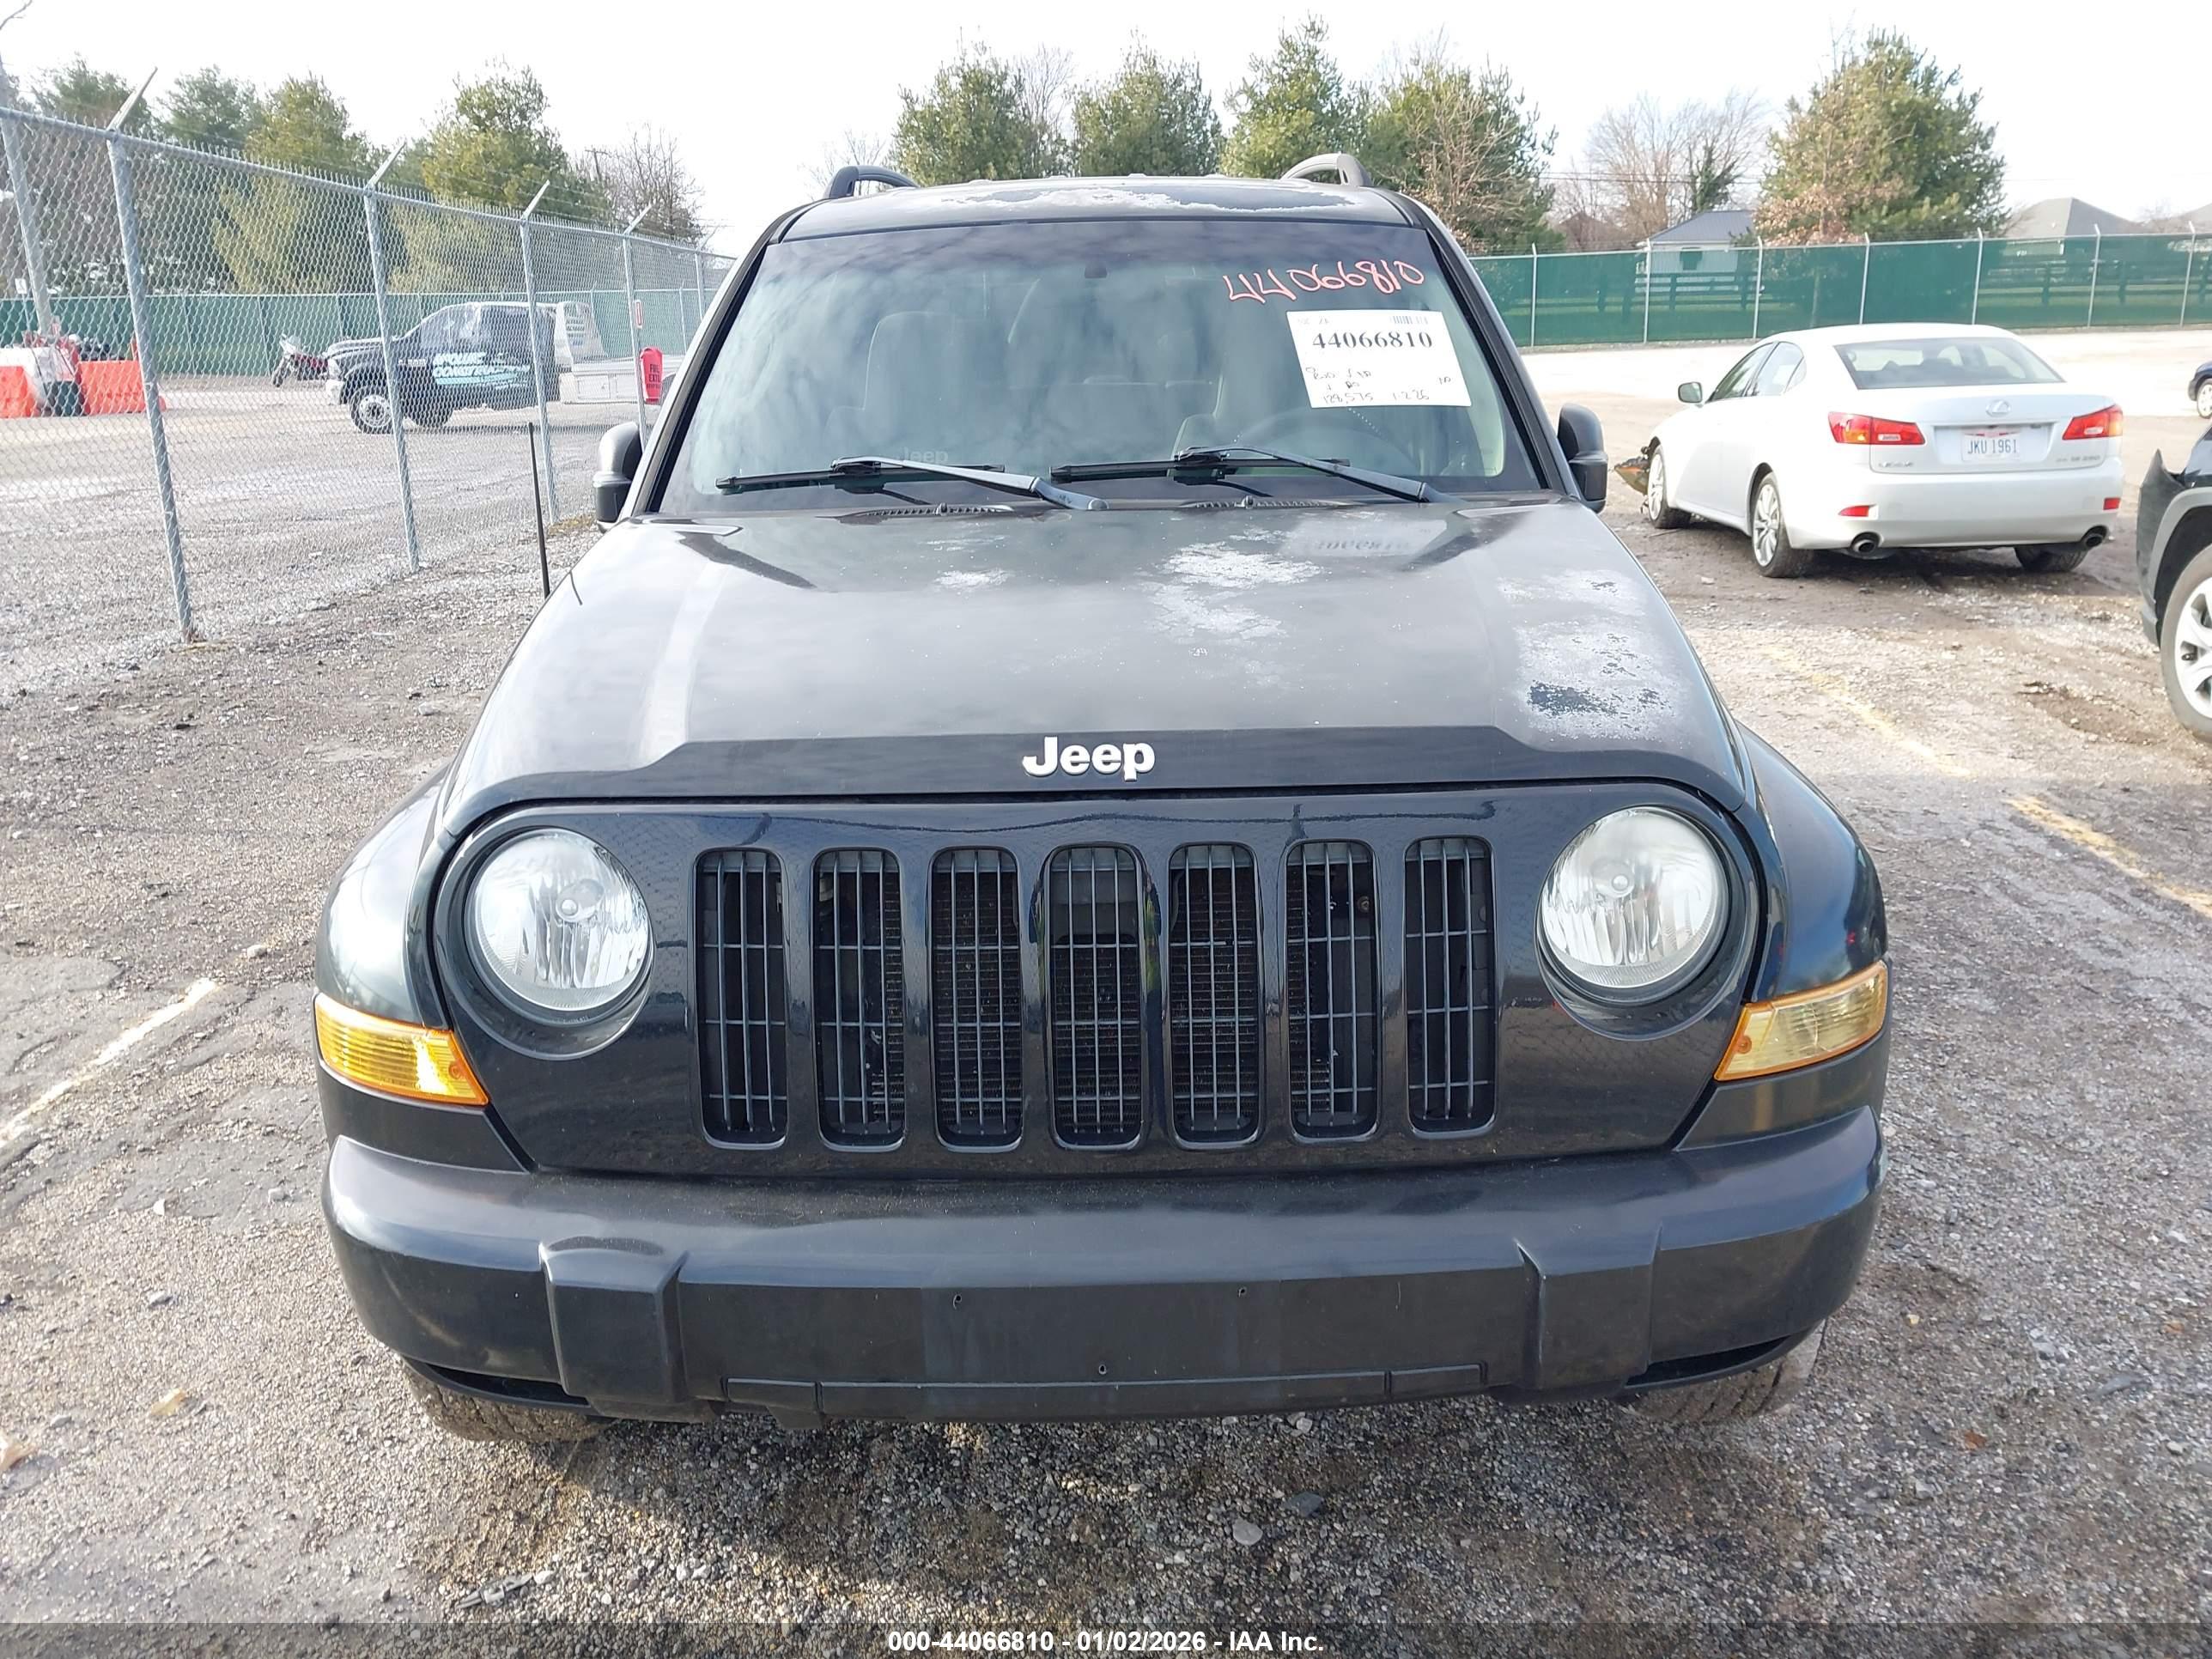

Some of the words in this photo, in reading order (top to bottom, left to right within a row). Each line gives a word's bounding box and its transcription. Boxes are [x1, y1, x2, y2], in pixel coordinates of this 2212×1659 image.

[1222, 259, 1425, 303] 44066810
[1312, 331, 1433, 349] 44066810
[1967, 439, 1987, 454] JKU
[1992, 439, 2017, 453] 1961
[1022, 736, 1156, 782] Jeep
